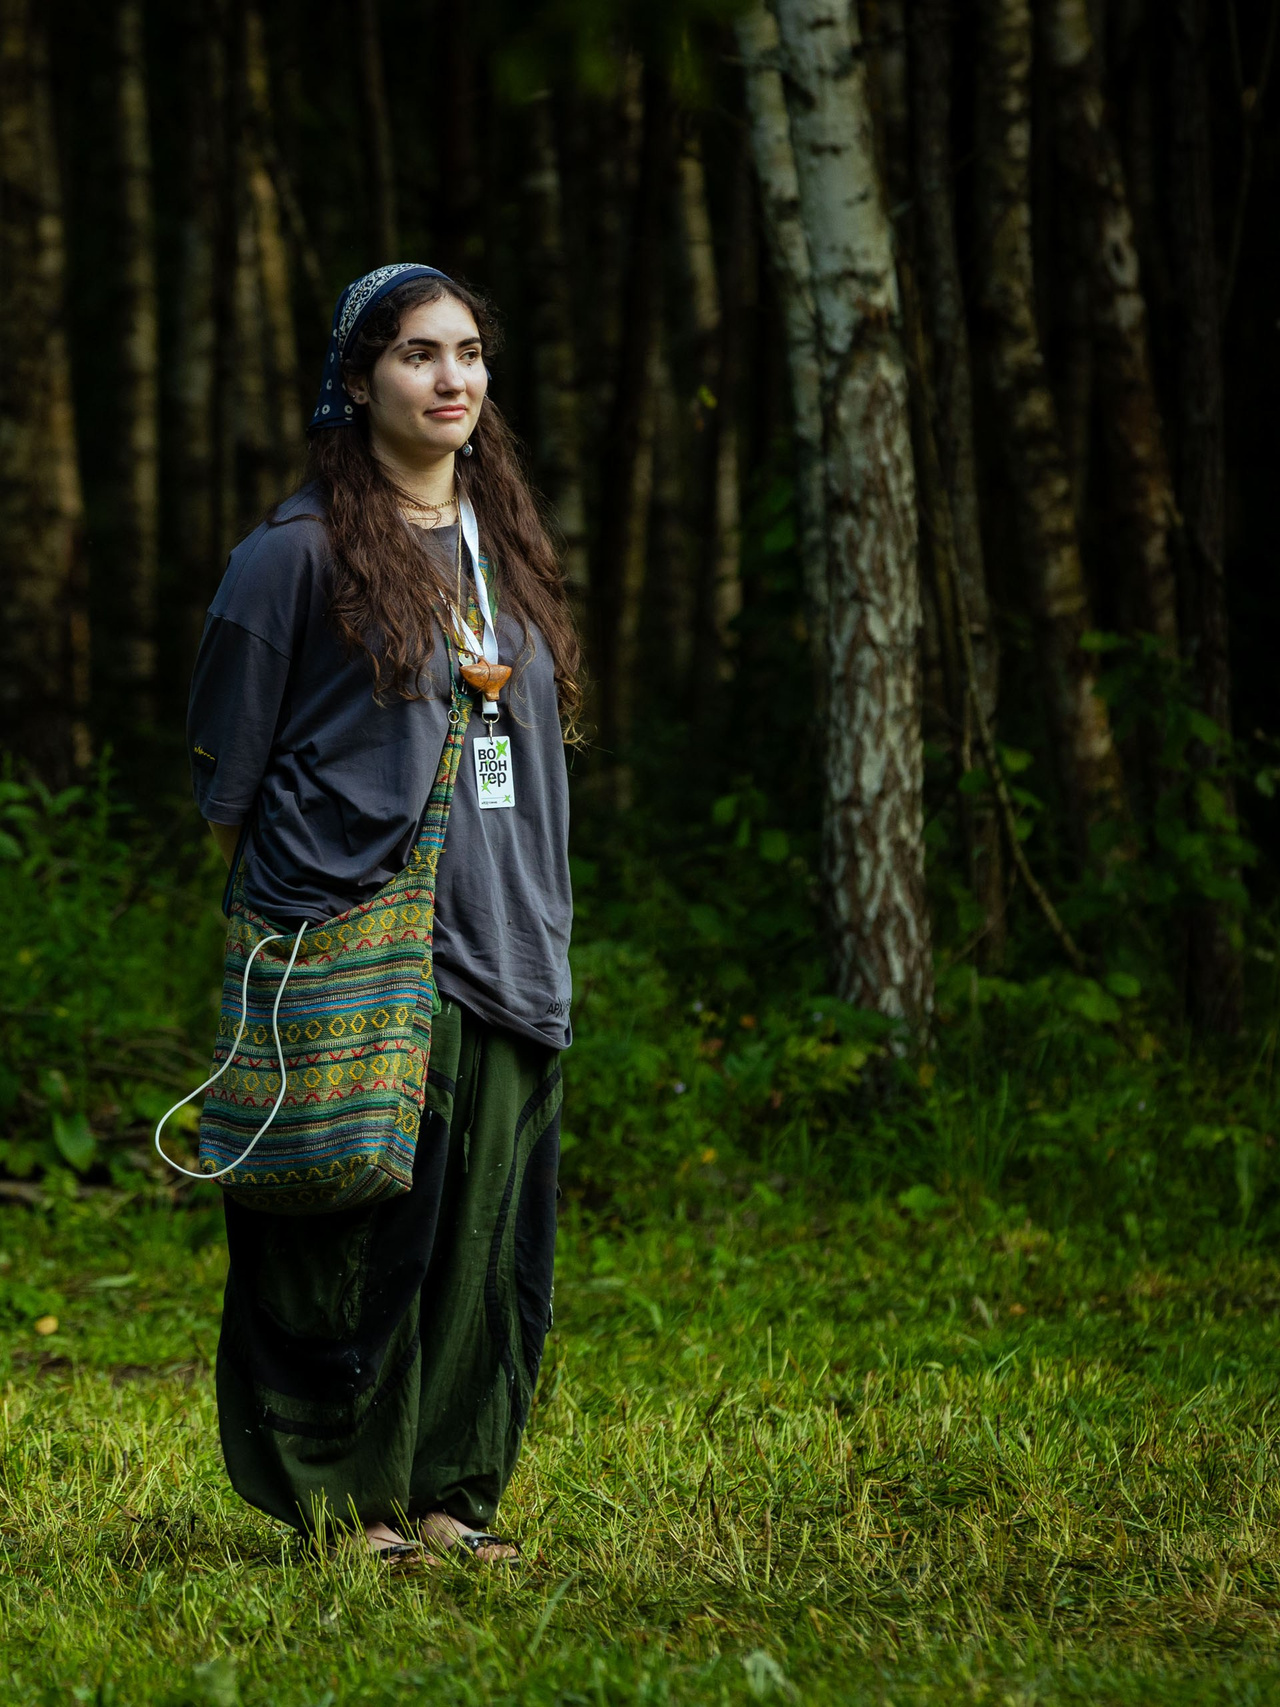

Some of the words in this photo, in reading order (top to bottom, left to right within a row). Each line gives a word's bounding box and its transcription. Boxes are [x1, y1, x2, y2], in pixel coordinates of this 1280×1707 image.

[478, 748, 496, 761] во
[479, 760, 507, 773] лон
[479, 771, 507, 787] тер
